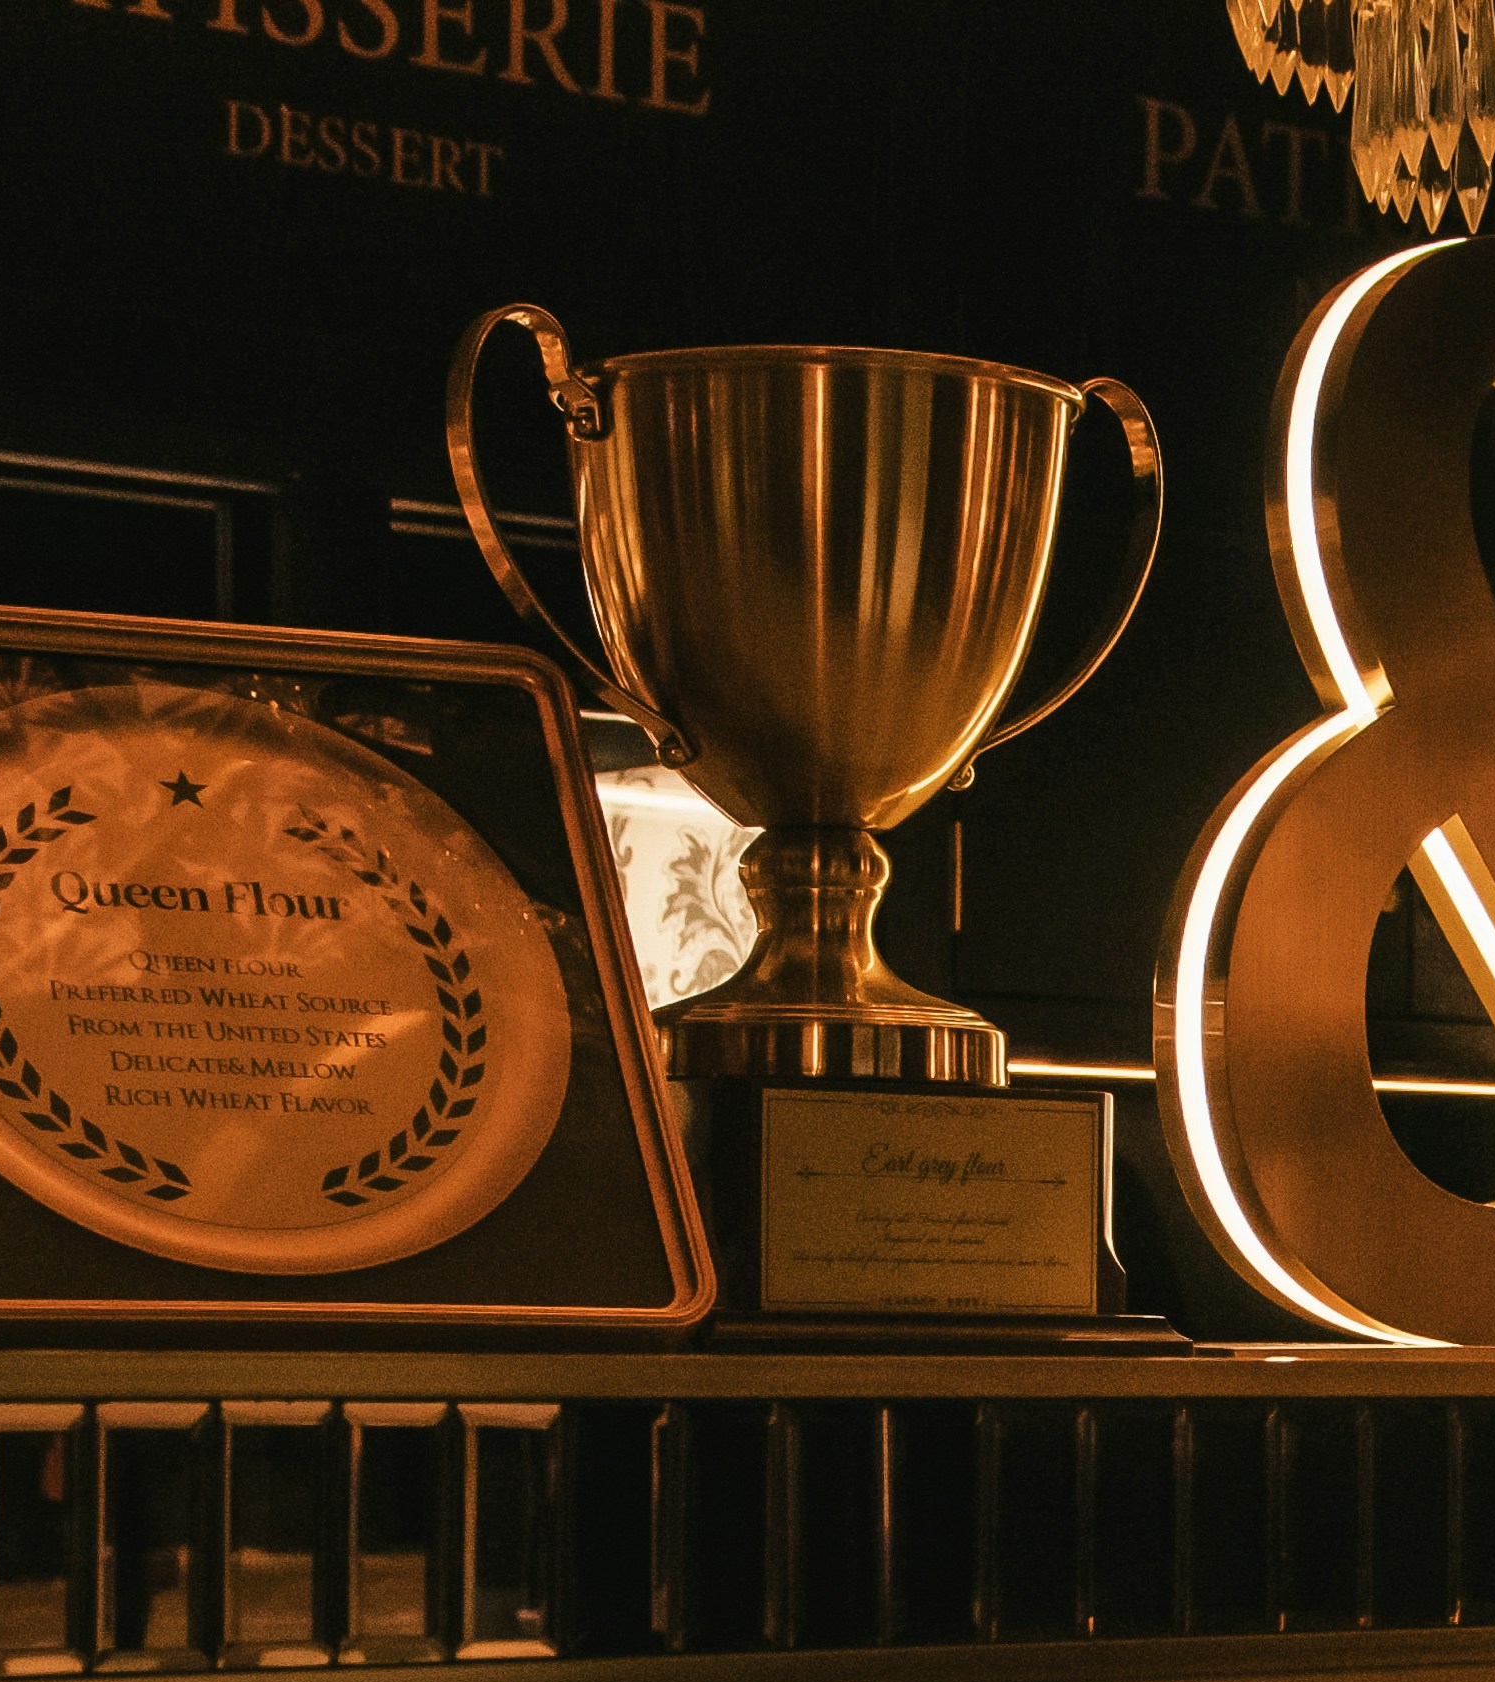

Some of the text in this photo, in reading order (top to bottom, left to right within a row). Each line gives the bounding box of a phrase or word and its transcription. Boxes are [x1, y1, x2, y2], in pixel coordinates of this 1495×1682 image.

[227, 98, 505, 199] DESSERT
[50, 871, 349, 921] Queen Flour
[861, 1143, 915, 1177] Earl
